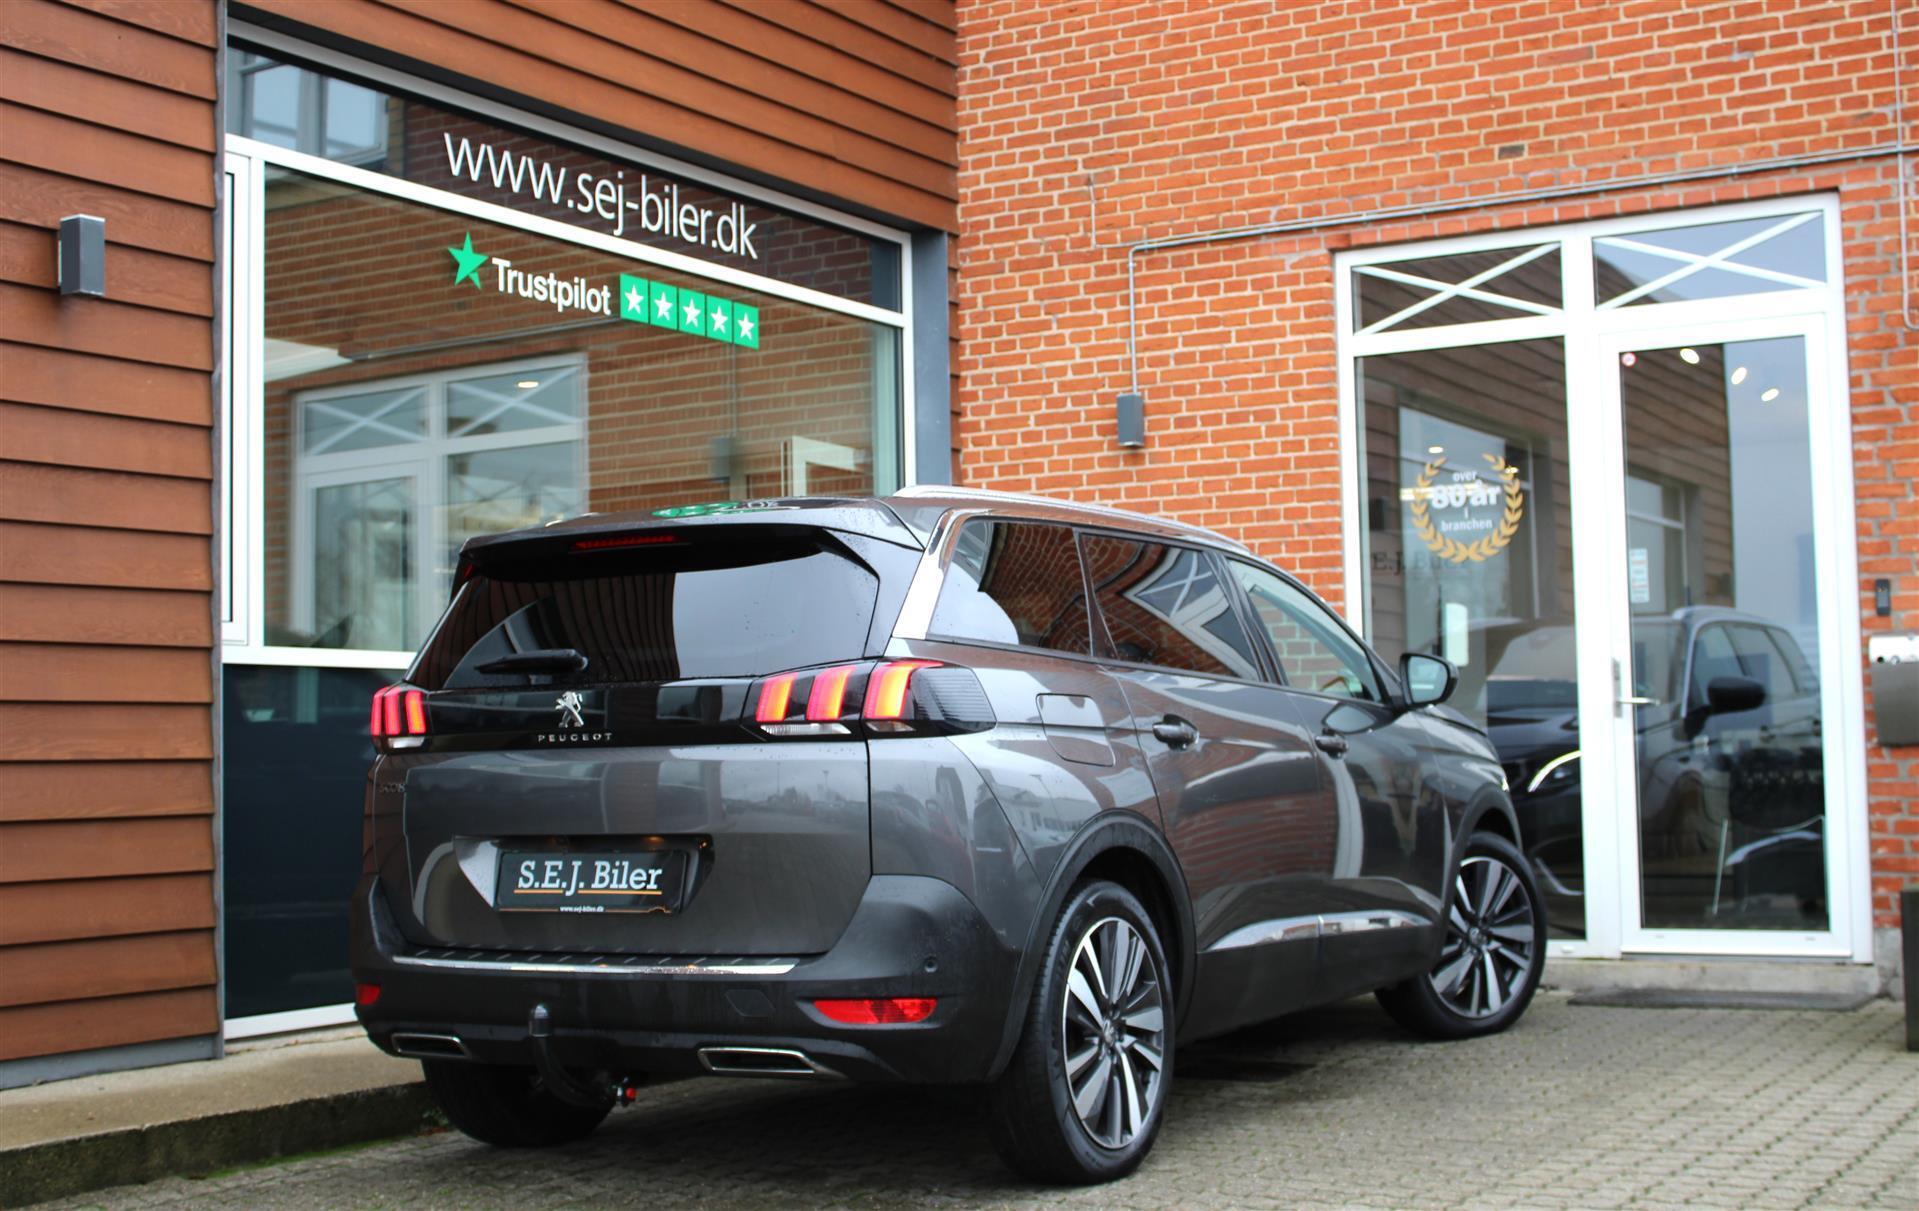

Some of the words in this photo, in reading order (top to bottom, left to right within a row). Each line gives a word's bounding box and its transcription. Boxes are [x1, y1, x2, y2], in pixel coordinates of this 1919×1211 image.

[443, 132, 759, 260] www.sej-biler.dk
[491, 257, 612, 316] Trustpilot
[1452, 471, 1478, 482] over
[1430, 483, 1466, 509] 80
[1470, 480, 1500, 506] år
[1441, 519, 1493, 532] branchen
[537, 733, 614, 742] PEUGEOT
[517, 859, 586, 897] S.E.J.
[591, 860, 663, 890] Biler
